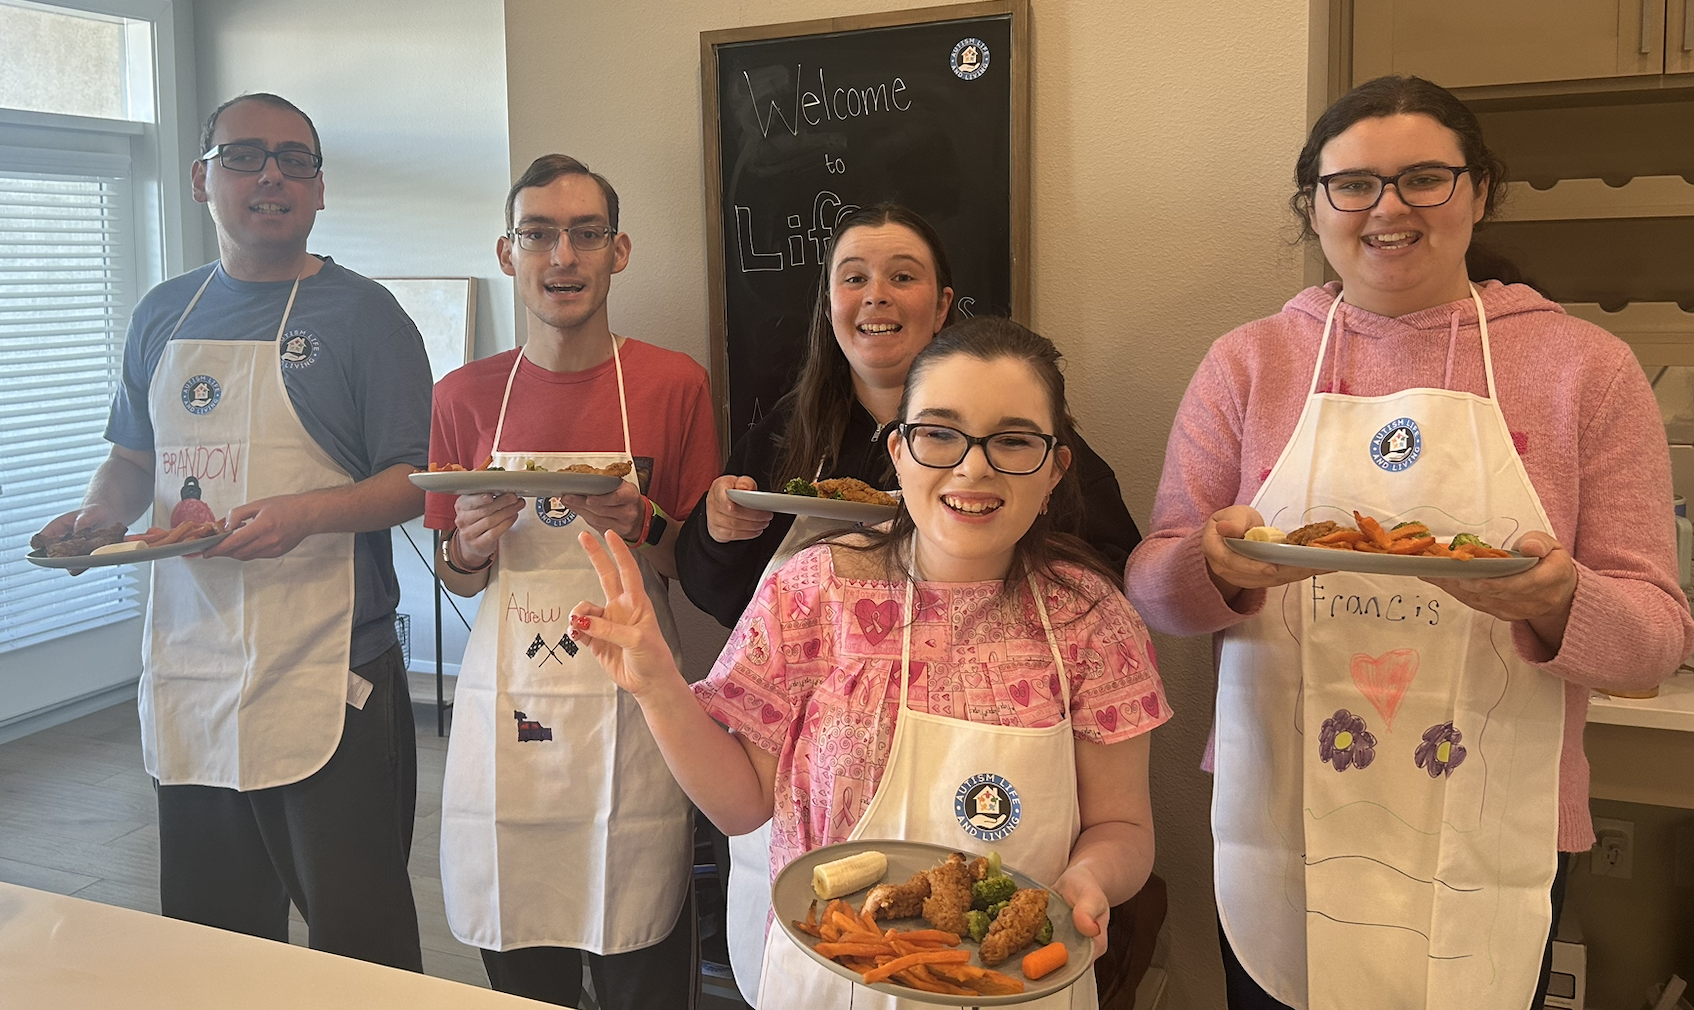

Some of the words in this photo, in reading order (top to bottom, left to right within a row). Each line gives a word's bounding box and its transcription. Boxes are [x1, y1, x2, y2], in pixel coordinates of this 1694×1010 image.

[951, 38, 975, 57] AUTISM
[977, 41, 990, 56] LIFE
[951, 65, 963, 78] AND
[965, 63, 989, 80] LIVING
[743, 63, 912, 138] Welcome
[824, 153, 846, 174] to
[734, 190, 862, 273] Lif
[308, 333, 320, 351] LIFE
[284, 357, 315, 369] LIVING
[183, 375, 206, 393] AUTISM
[208, 377, 220, 392] LIFE
[184, 400, 195, 413] AND
[197, 399, 219, 415] LIVING
[1373, 419, 1404, 445] AUTISM
[1406, 419, 1420, 437] LIFE
[162, 438, 242, 483] BRANDON
[1372, 454, 1389, 469] AND
[1392, 446, 1421, 471] LIVING
[538, 511, 551, 524] AND
[554, 511, 576, 526] LIVIN
[506, 591, 561, 623] Andrew
[1312, 575, 1439, 626] Francis
[956, 774, 995, 802] AUTISM
[999, 778, 1021, 805] LIFE
[957, 816, 978, 836] AND
[982, 816, 1020, 841] LIVING
